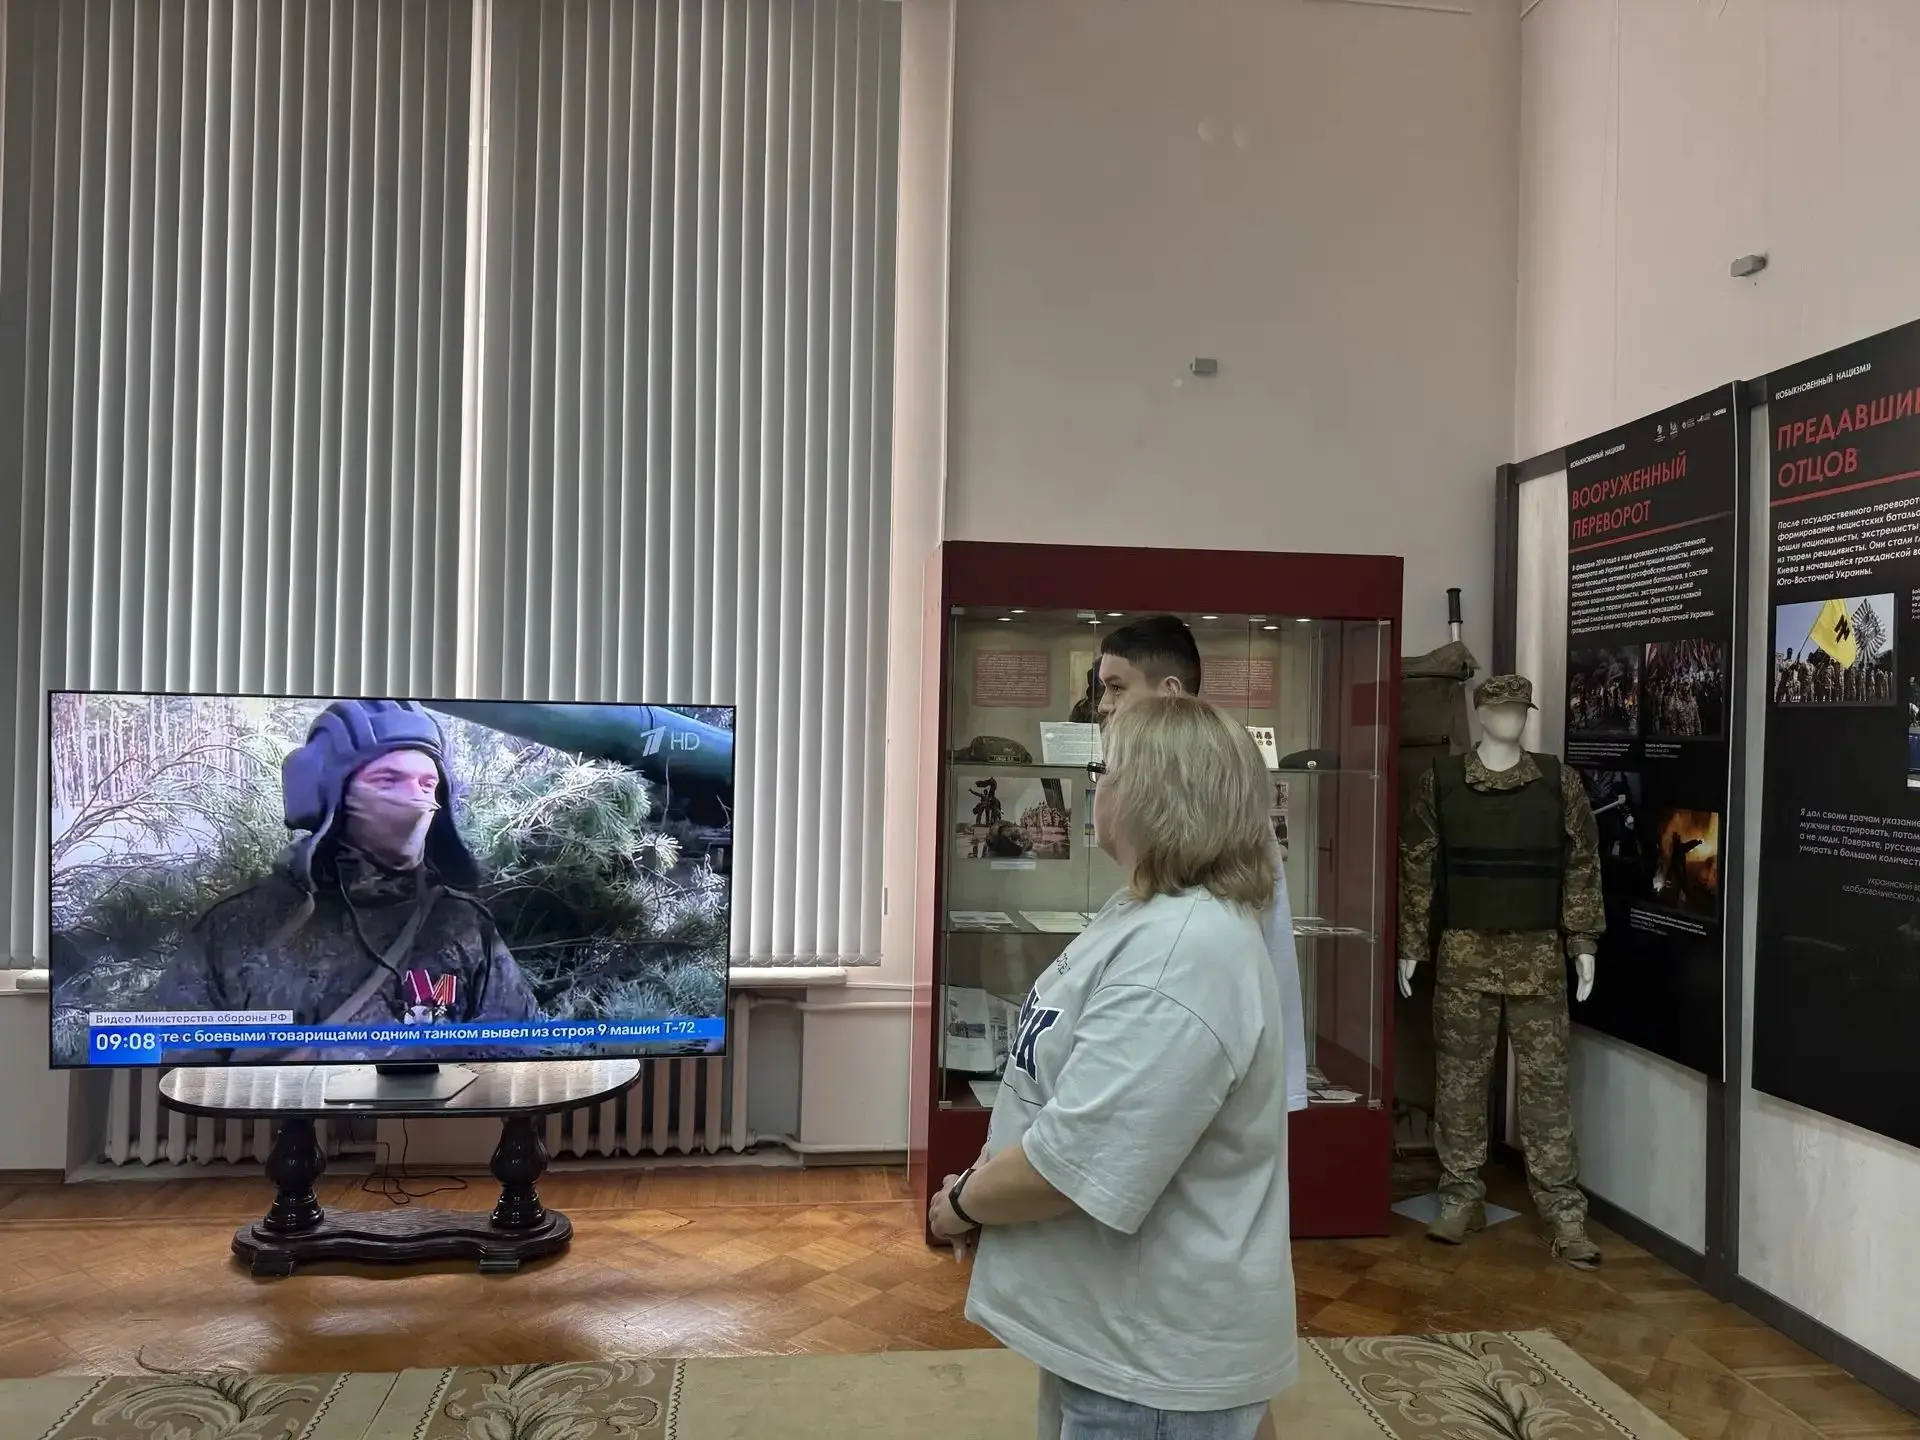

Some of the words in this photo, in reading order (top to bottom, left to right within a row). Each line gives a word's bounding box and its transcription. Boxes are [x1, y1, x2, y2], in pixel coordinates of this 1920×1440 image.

[1778, 448, 1857, 488] ОТЦОВ
[1572, 450, 1687, 509] ВООРУЖЕННЫЙ
[1572, 500, 1652, 540] ПЕРЕВОРОТ
[1777, 520, 1800, 530] После
[1801, 506, 1871, 526] государственного
[1777, 544, 1800, 552] вошли
[1802, 534, 1858, 548] националисты,
[1861, 522, 1918, 538] экстремисты
[1778, 525, 1835, 542] формирование
[1836, 516, 1884, 530] нацистских
[1633, 548, 1658, 559] кровавого
[1690, 546, 1714, 556] которые
[1777, 556, 1784, 564] из
[1786, 554, 1812, 563] тюрем
[1813, 544, 1866, 560] рецидивисты.
[1869, 540, 1886, 550] Они
[1888, 537, 1913, 546] стали
[1777, 564, 1798, 575] Киева
[1800, 564, 1804, 572] в
[1806, 557, 1853, 571] начавшейся
[1855, 547, 1911, 566] гражданской
[1616, 578, 1652, 591] формирование
[1689, 569, 1708, 577] состав
[1631, 566, 1666, 580] русофобскую
[1776, 570, 1834, 586] Юго-Восточной
[1836, 568, 1872, 580] Украины.
[1800, 808, 1806, 816] Я
[1822, 812, 1847, 820] своим
[1849, 814, 1880, 823] врачам
[1800, 821, 1830, 830] мужчин
[1832, 824, 1890, 837] кастрировать,
[1818, 835, 1840, 844] люди.
[1842, 836, 1882, 850] Поверьте,
[1800, 844, 1831, 855] умирать
[1840, 848, 1877, 860] большом
[96, 1014, 131, 1024] Видео
[135, 1014, 214, 1024] Министерства
[217, 1014, 267, 1024] обороны
[270, 1013, 287, 1021] РФ
[96, 1032, 156, 1050] 09:08
[182, 1032, 191, 1042] с
[194, 1030, 265, 1042] боевыми
[269, 1030, 368, 1043] товарищами
[371, 1029, 419, 1041] одним
[424, 1029, 478, 1039] танком
[482, 1028, 528, 1038] вывел
[532, 1028, 549, 1037] из
[552, 1026, 594, 1039] строя
[598, 1024, 607, 1036] 9
[610, 1026, 660, 1036] машин
